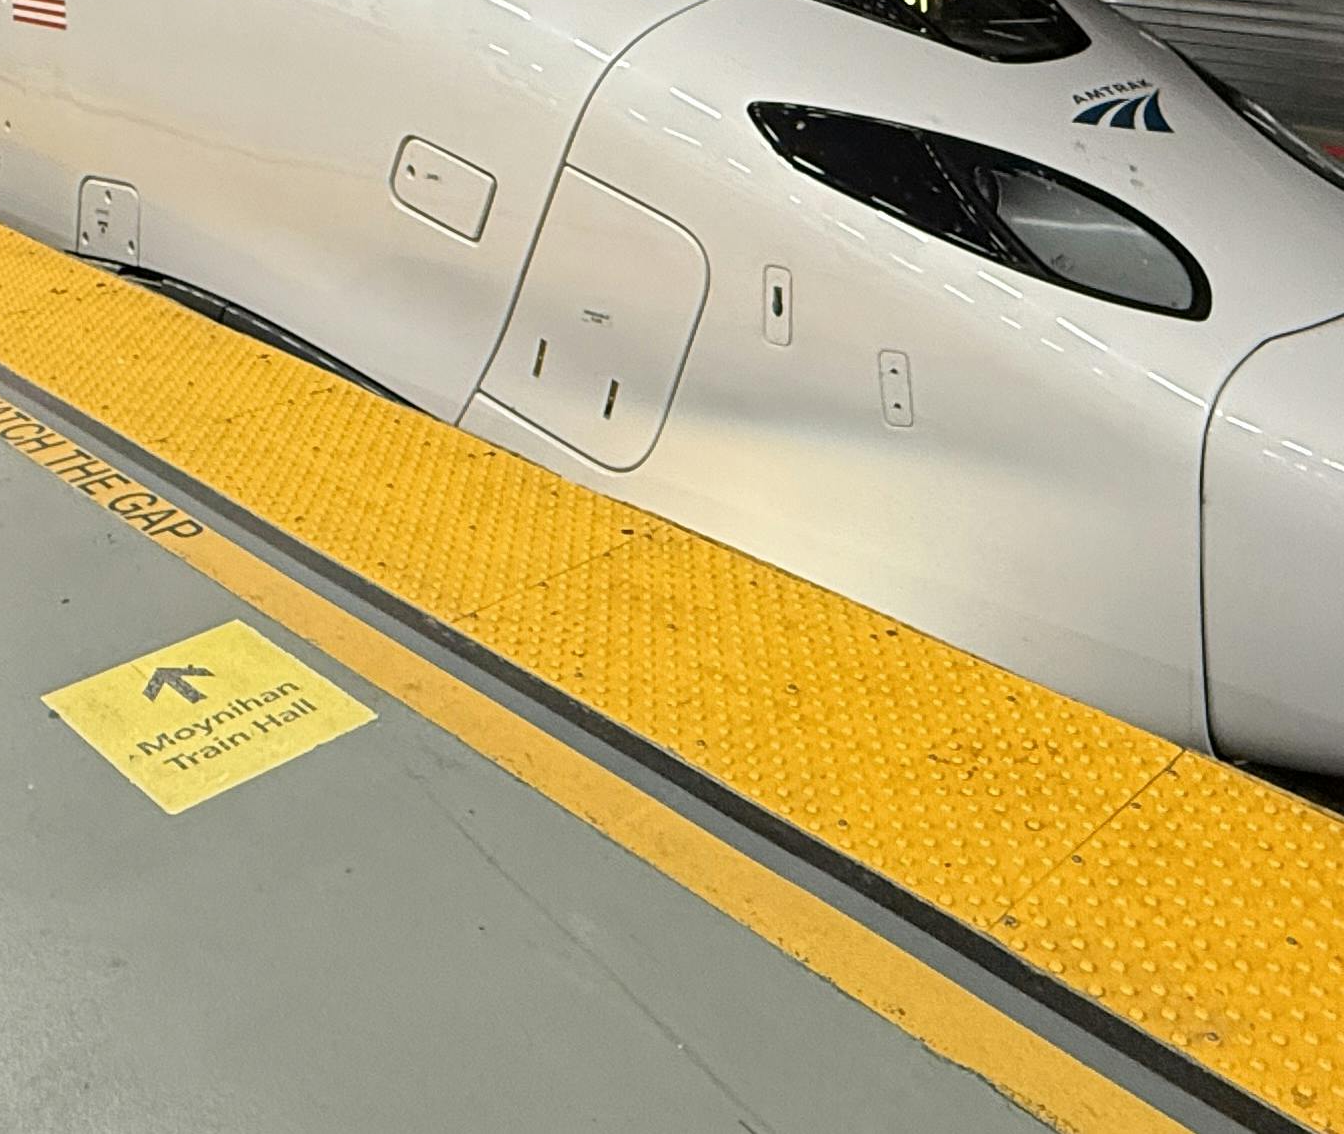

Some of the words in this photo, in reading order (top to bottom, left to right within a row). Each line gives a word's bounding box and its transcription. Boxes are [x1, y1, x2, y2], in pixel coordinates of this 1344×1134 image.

[1072, 78, 1154, 105] AMTRAK
[44, 448, 130, 496] THE
[107, 491, 204, 538] GAP
[135, 681, 301, 756] Moynihan
[163, 730, 251, 770] Train
[251, 697, 318, 734] Hall
